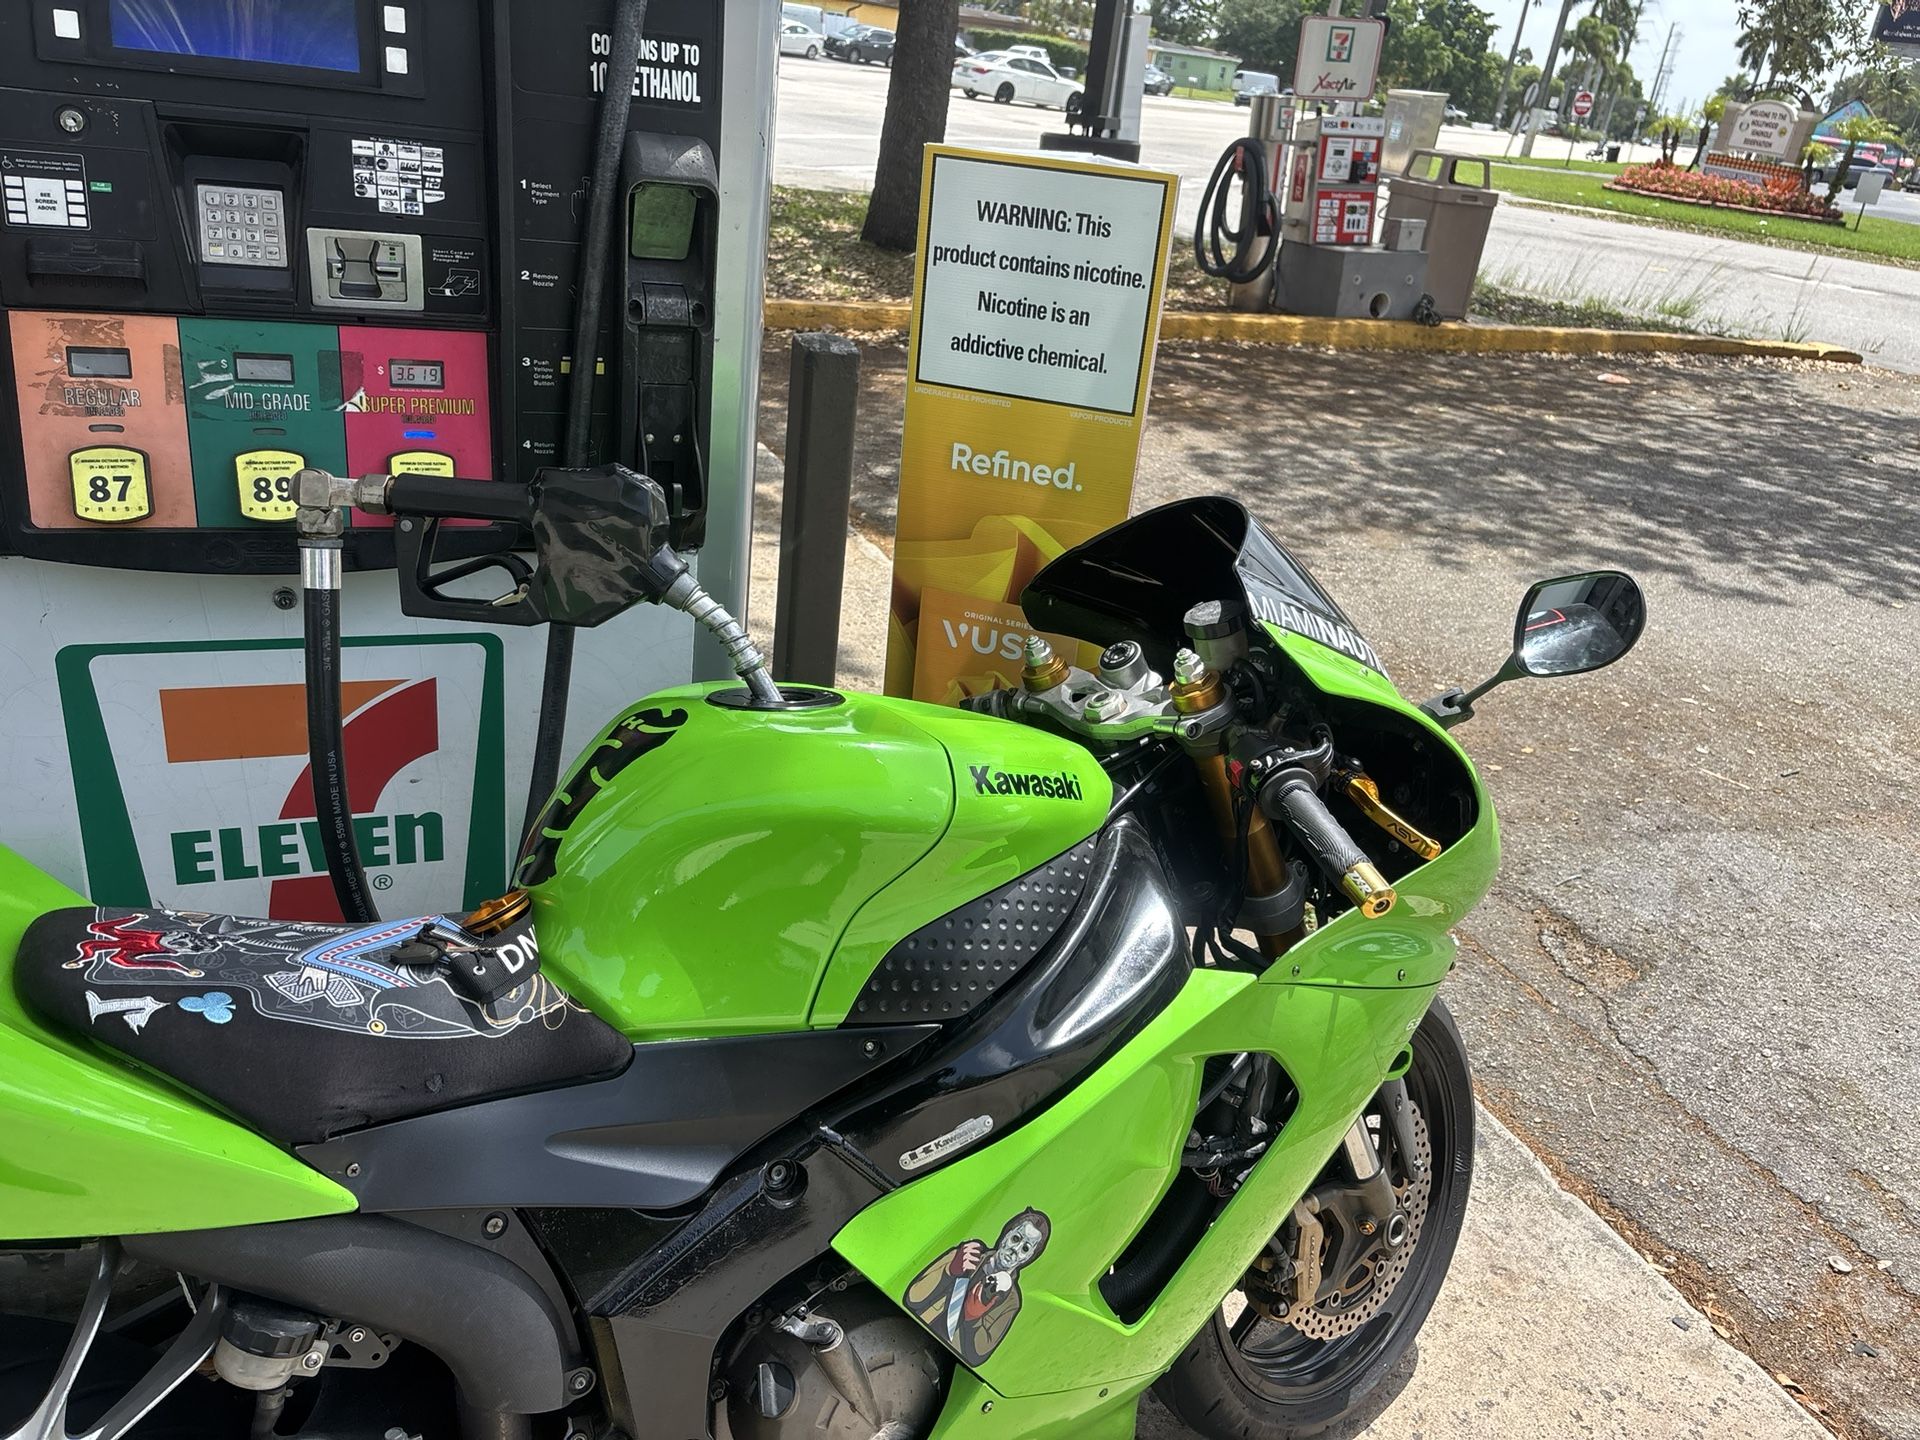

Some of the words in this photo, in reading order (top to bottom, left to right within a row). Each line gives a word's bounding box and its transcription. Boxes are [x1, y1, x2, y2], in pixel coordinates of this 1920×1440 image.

[591, 32, 658, 62] CONS
[661, 41, 680, 63] UP
[682, 44, 700, 66] TO
[590, 61, 608, 93] 10
[631, 66, 701, 103] ETHANOL
[1324, 121, 1338, 129] VISA
[1751, 120, 1779, 129] HOLLYWOOD
[355, 175, 375, 184] STAR
[520, 179, 526, 189] 1
[531, 182, 552, 190] Select
[380, 188, 399, 197] VISA
[531, 190, 560, 198] Payment
[532, 197, 547, 206] Type
[977, 200, 1072, 233] WARNING:
[1076, 212, 1112, 239] This
[520, 270, 530, 280] 2
[933, 244, 996, 269] product
[999, 254, 1070, 279] contains
[1073, 260, 1146, 290] nicotine.
[977, 290, 1048, 321] Nicotine
[1051, 301, 1066, 324] is
[1069, 309, 1090, 327] an
[522, 357, 531, 367] 3
[950, 333, 1025, 362] addictive
[1028, 343, 1108, 375] chemical.
[397, 367, 438, 382] 3.619
[64, 387, 142, 407] REGULAR
[224, 391, 312, 411] MID-GRADE
[364, 395, 406, 415] SUPER
[411, 397, 475, 416] PREMIUM
[914, 386, 951, 399] UNDERAGE
[952, 391, 970, 402] SALE
[971, 394, 1012, 409] PROHIBITED
[1069, 411, 1093, 422] VAPOR
[1094, 415, 1133, 427] PRODUCTS
[523, 440, 531, 449] 4
[951, 442, 1083, 492] Refined.
[89, 476, 132, 503] 87
[253, 476, 292, 502] 89
[964, 611, 1003, 625] ORIGINAL
[943, 619, 1024, 660] VUS
[328, 750, 336, 771] USA
[329, 774, 337, 785] IN
[969, 765, 1082, 800] Kawasaki
[331, 786, 341, 816] MADE
[335, 817, 346, 840] 559N
[1387, 822, 1419, 843] ASV
[342, 852, 351, 865] BY
[346, 869, 361, 891] HOSE
